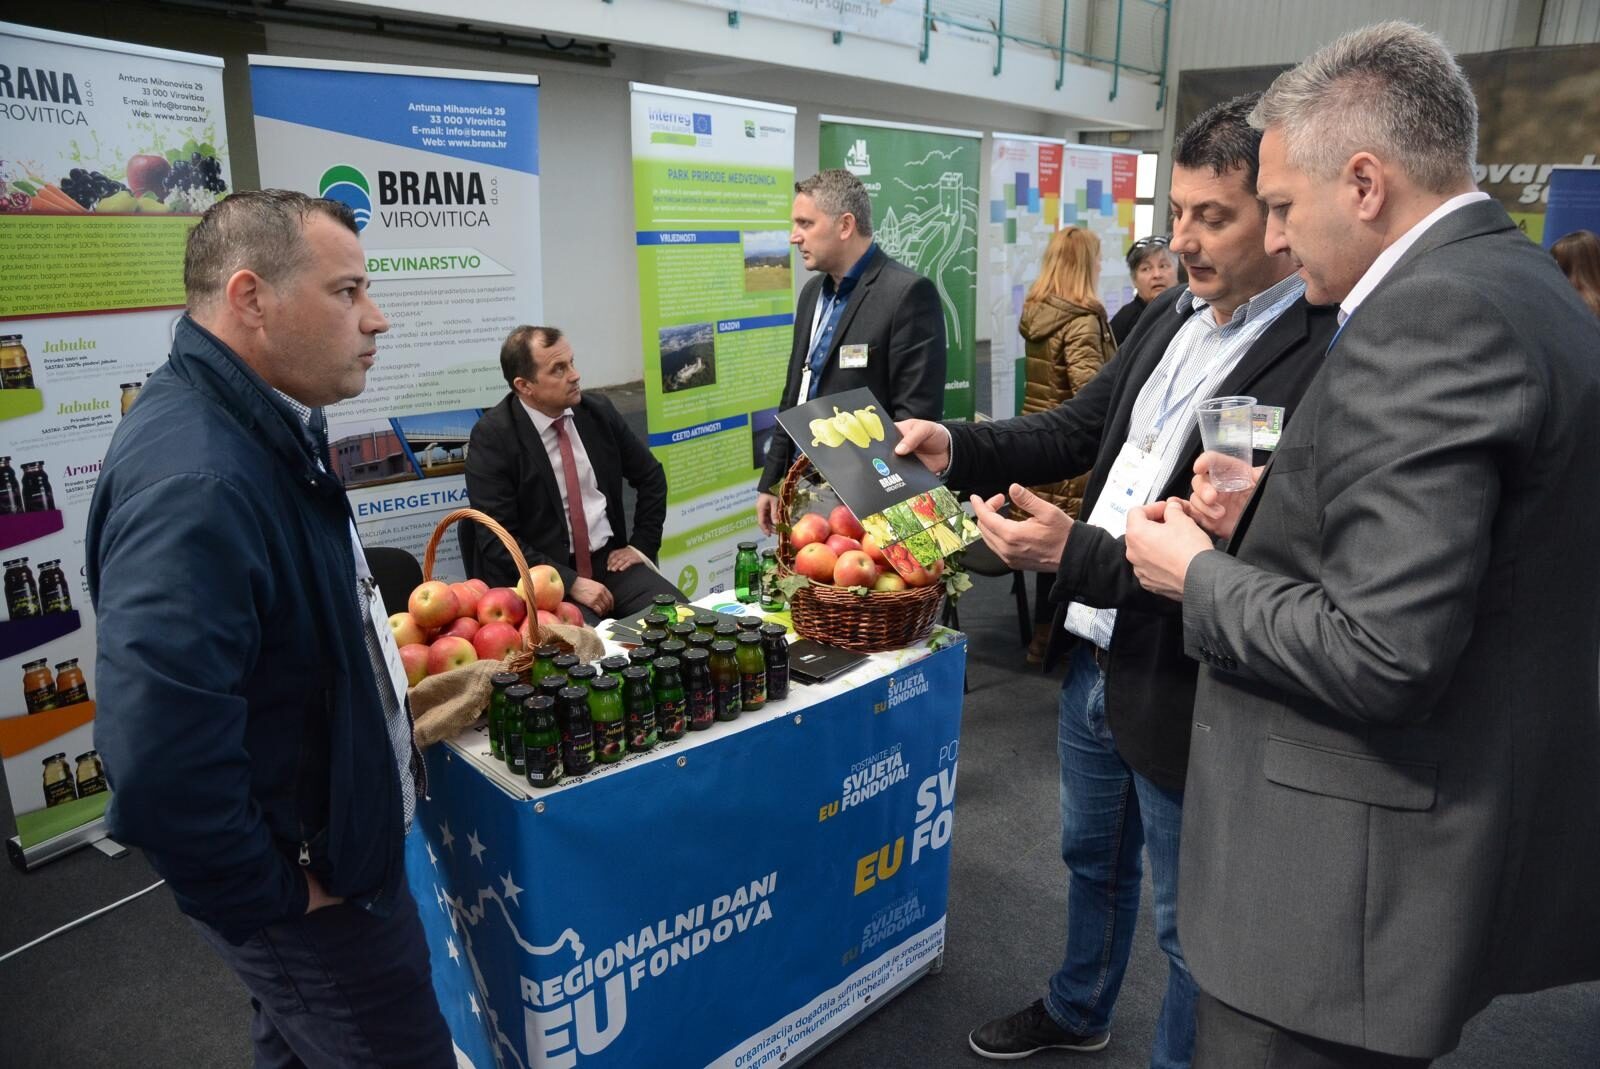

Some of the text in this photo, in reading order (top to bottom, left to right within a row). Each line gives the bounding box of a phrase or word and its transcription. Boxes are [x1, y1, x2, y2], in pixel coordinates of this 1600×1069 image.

[0, 64, 82, 106] RANA
[118, 73, 148, 84] Antuna
[194, 82, 203, 91] 29
[122, 96, 206, 112] E-mail: info@brana.hr
[142, 87, 205, 102] 33 000 Virovitica
[0, 103, 88, 126] ROVITICA
[131, 108, 207, 123] Web: www.brana.hr
[408, 102, 506, 116] Antuna Mihanovića 29
[412, 125, 507, 138] E-mail: info@brana.hr
[430, 115, 506, 127] 33 000 Virovitica
[422, 137, 507, 149] Web: www.brana.hr
[667, 168, 776, 186] PARK PRIRODE MEDVEDNICA
[377, 170, 498, 206] BRANA d.o.o.
[380, 210, 490, 228] VIROVITICA
[660, 233, 697, 242] VRIJEDNOSTI
[719, 321, 741, 332] IZAZOVI
[42, 336, 97, 354] Jabuka
[57, 397, 111, 416] Jabuka
[671, 428, 691, 442] CEETO
[63, 459, 102, 477] Aroni
[878, 472, 904, 489] BRANA
[357, 488, 469, 517] ENERGETIKA
[360, 528, 392, 539] RACIJSKA
[888, 673, 925, 699] SVIJETA
[874, 681, 929, 714] EU FONDOVA!
[851, 749, 889, 774] POSTANITE
[939, 739, 959, 769] PO
[842, 751, 903, 796] SVIJETA
[818, 763, 910, 823] EU FONDOVA!
[915, 761, 958, 824] SV
[854, 809, 953, 897] EU FO
[863, 895, 919, 940] SVIJETA
[519, 903, 705, 1007] REGIONALNI
[711, 871, 778, 921] DANI
[860, 904, 927, 955] FONDOVA!
[523, 899, 773, 1069] EU FONDOVA
[734, 1024, 793, 1068] Organizacija
[837, 961, 890, 1001] sufinancirana
[891, 955, 900, 967] je
[900, 929, 943, 958] sredstvima
[747, 1045, 781, 1069] ograma
[896, 963, 904, 973] iz
[904, 937, 943, 968] Europskog
